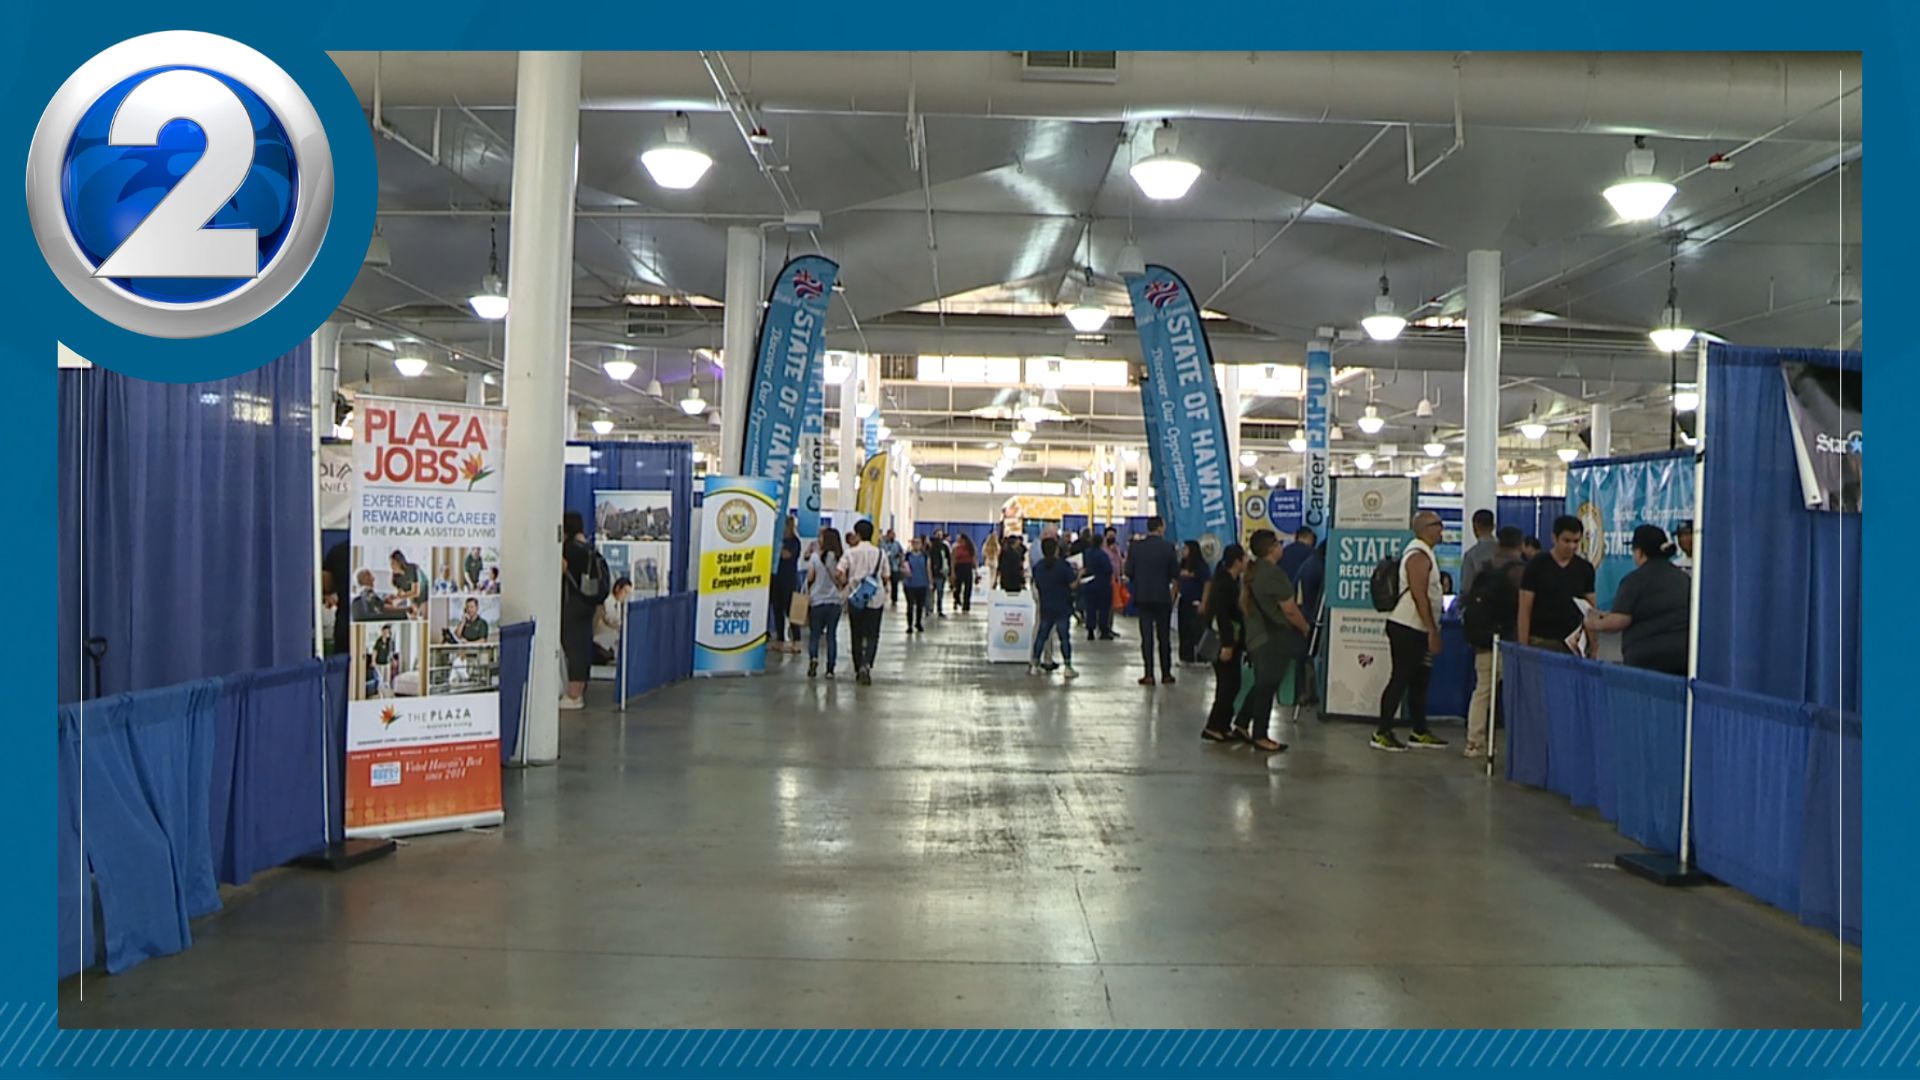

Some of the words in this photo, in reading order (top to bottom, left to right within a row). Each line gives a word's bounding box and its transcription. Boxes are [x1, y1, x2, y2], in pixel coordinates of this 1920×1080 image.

[784, 309, 814, 383] STATE
[1167, 314, 1203, 387] STATE
[779, 385, 798, 419] OF
[1162, 400, 1175, 424] Our
[1184, 391, 1210, 421] OF
[1307, 377, 1327, 448] EXPO
[364, 408, 488, 450] PLAZA
[364, 446, 459, 484] JOBS
[1306, 453, 1326, 527] Career
[362, 494, 443, 510] EXPERIENCE
[446, 497, 456, 509] A
[362, 510, 444, 524] REWARDING
[447, 511, 496, 525] CAREER
[389, 526, 421, 536] PLAZA
[423, 527, 465, 537] ASSISTED
[467, 528, 496, 538] LIVING
[717, 551, 742, 565] State
[744, 549, 755, 561] of
[1340, 536, 1401, 563] STATE
[719, 562, 753, 576] Hawaii
[1339, 564, 1375, 578] RECRU
[712, 575, 762, 590] Employers
[1338, 579, 1371, 600] OFF
[714, 606, 750, 619] Career
[714, 619, 750, 635] EXPO
[408, 711, 426, 722] THE
[430, 708, 471, 721] PLAZA
